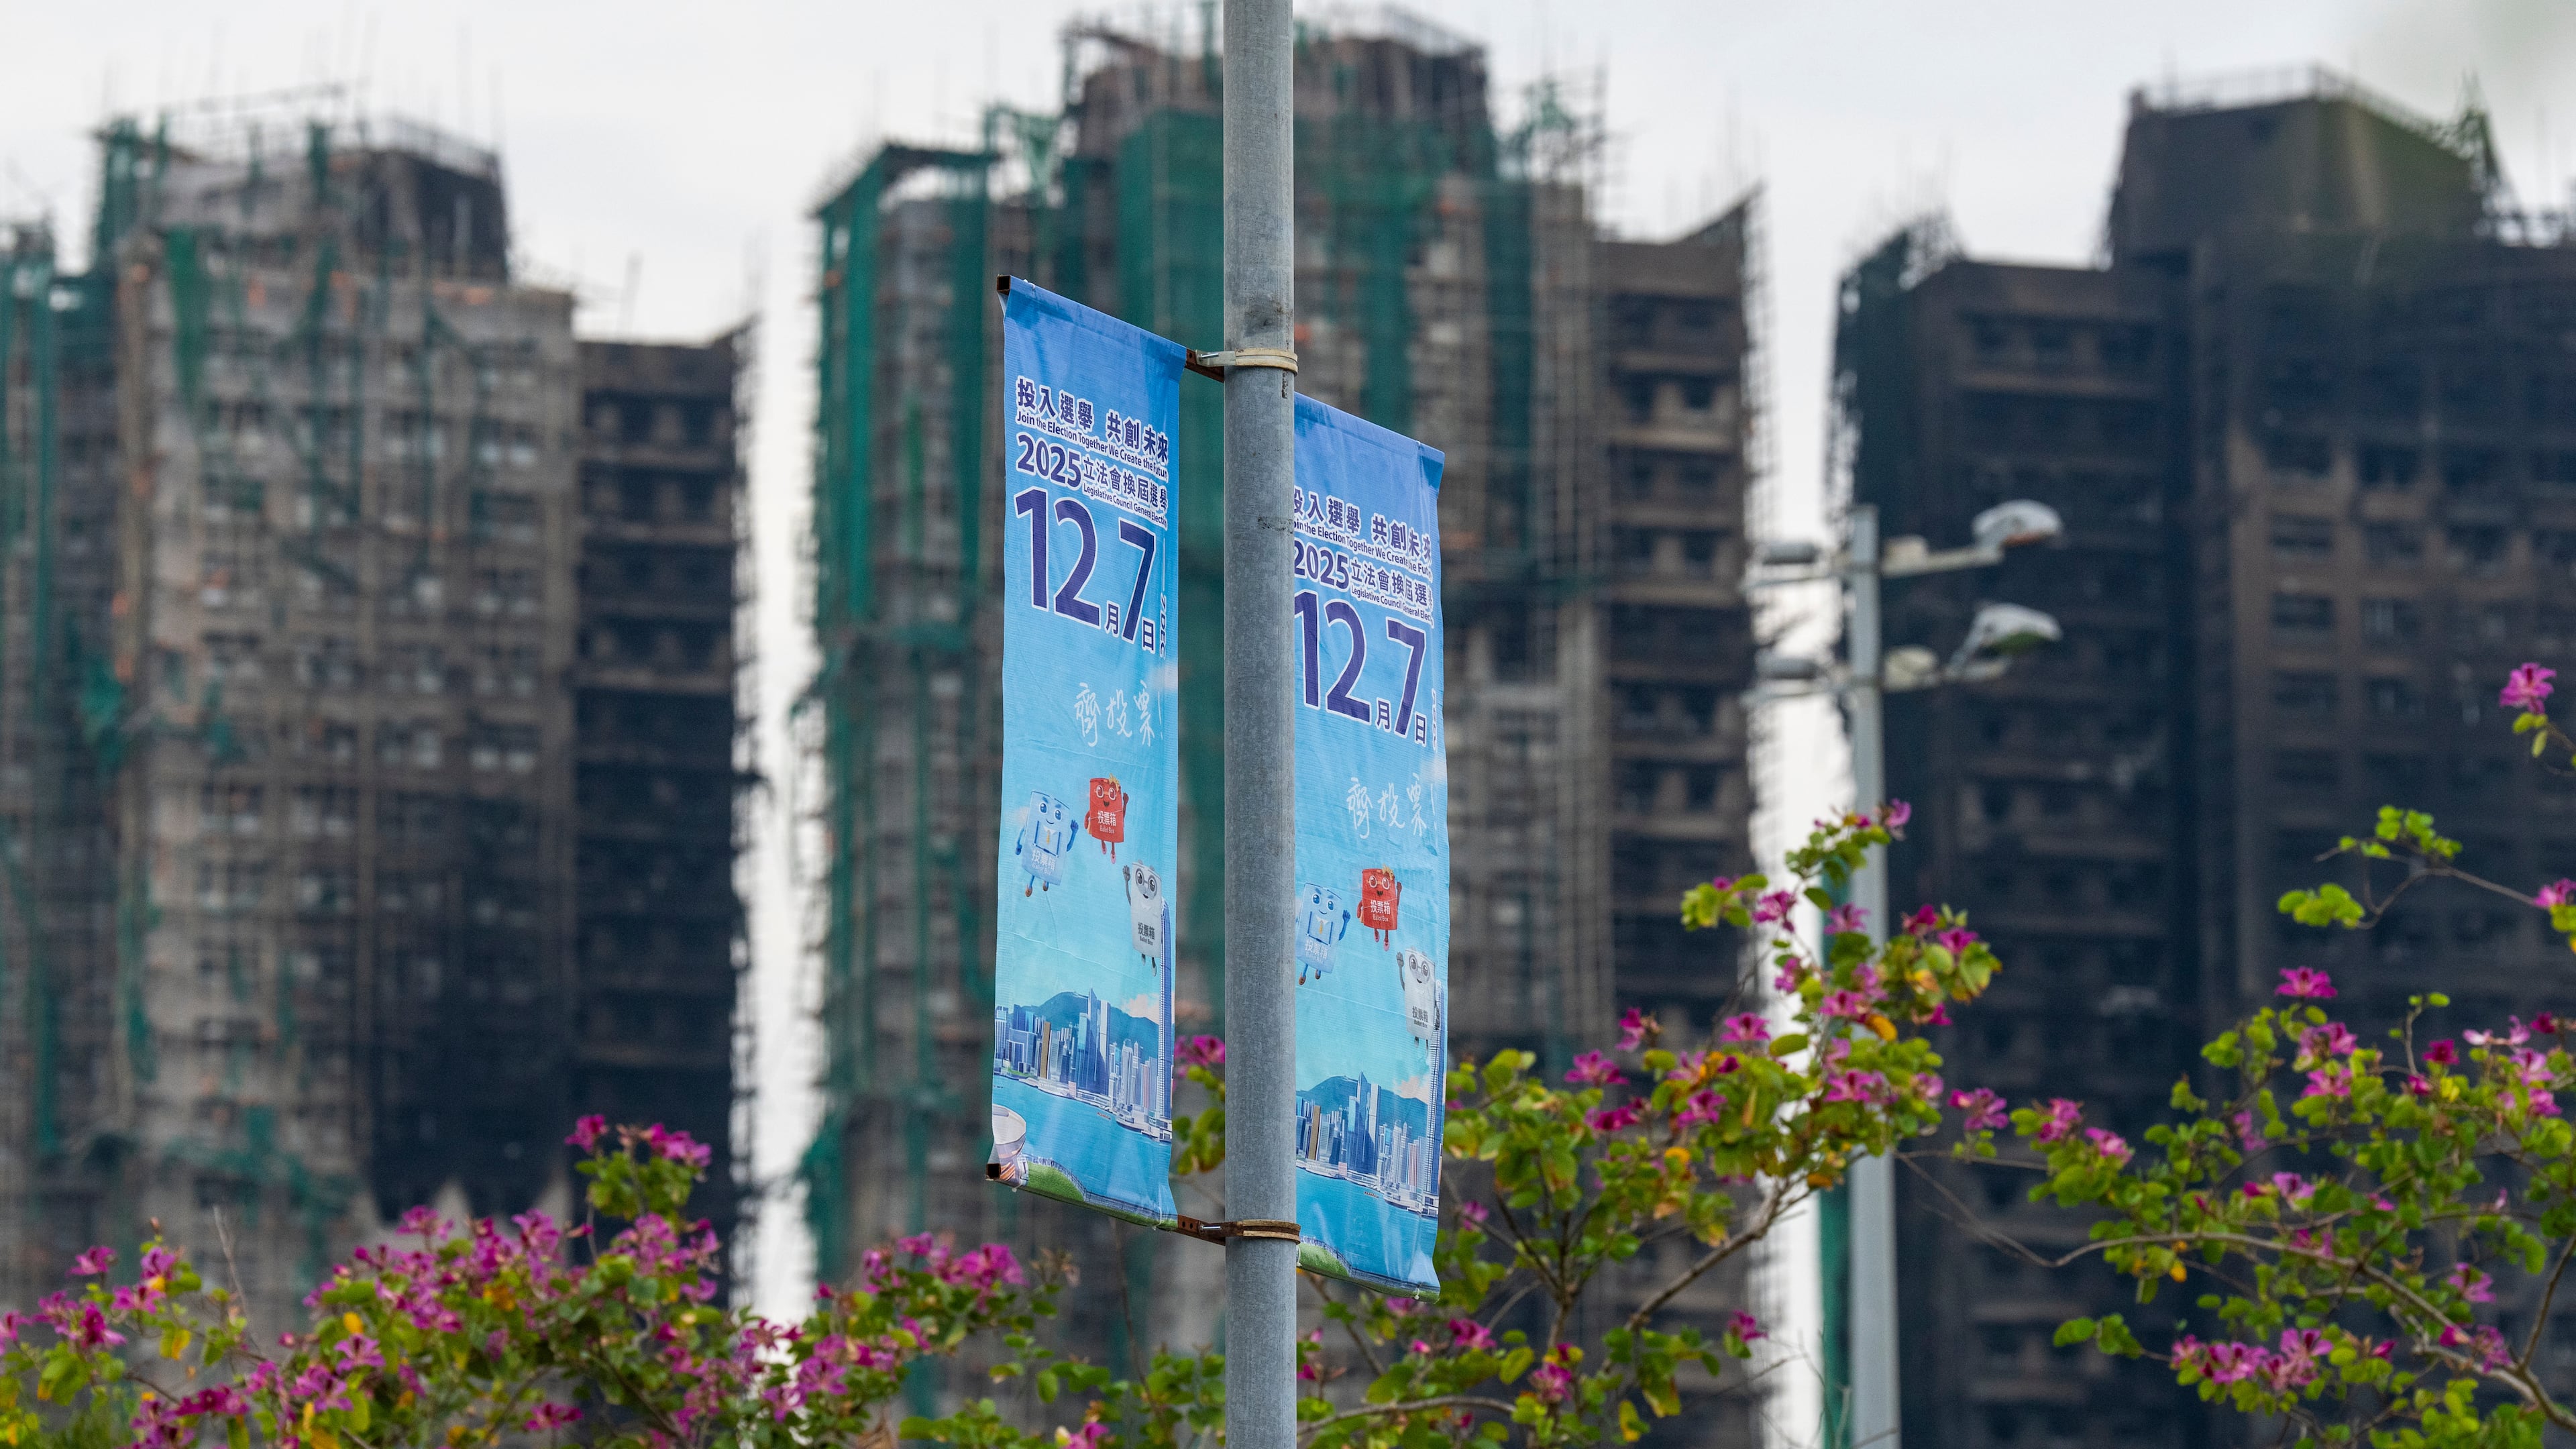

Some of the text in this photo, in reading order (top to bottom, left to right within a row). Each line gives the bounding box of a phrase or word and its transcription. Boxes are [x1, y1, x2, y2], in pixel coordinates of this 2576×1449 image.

[1018, 378, 1168, 463] 投入選舉 共創未來
[1017, 411, 1035, 426] Join
[1036, 417, 1046, 431] the
[1048, 421, 1077, 441] Election
[1078, 431, 1108, 453] Together
[1109, 444, 1119, 458] We
[1120, 449, 1142, 466] Create
[1143, 458, 1153, 471] the
[1083, 482, 1112, 502] Legislative
[1113, 494, 1133, 511] Council
[1134, 503, 1151, 518] General
[1294, 519, 1303, 531] oin
[1304, 522, 1316, 535] the
[1318, 527, 1345, 544] Election
[1346, 536, 1375, 555] Together
[1375, 547, 1386, 559] We
[1351, 585, 1380, 602] Legislative
[1381, 595, 1402, 609] Council
[1097, 810, 1116, 826] 投票箱
[1371, 900, 1391, 915] 投票箱
[1138, 922, 1155, 941] 投票箱
[1412, 1006, 1428, 1023] 投票箱
